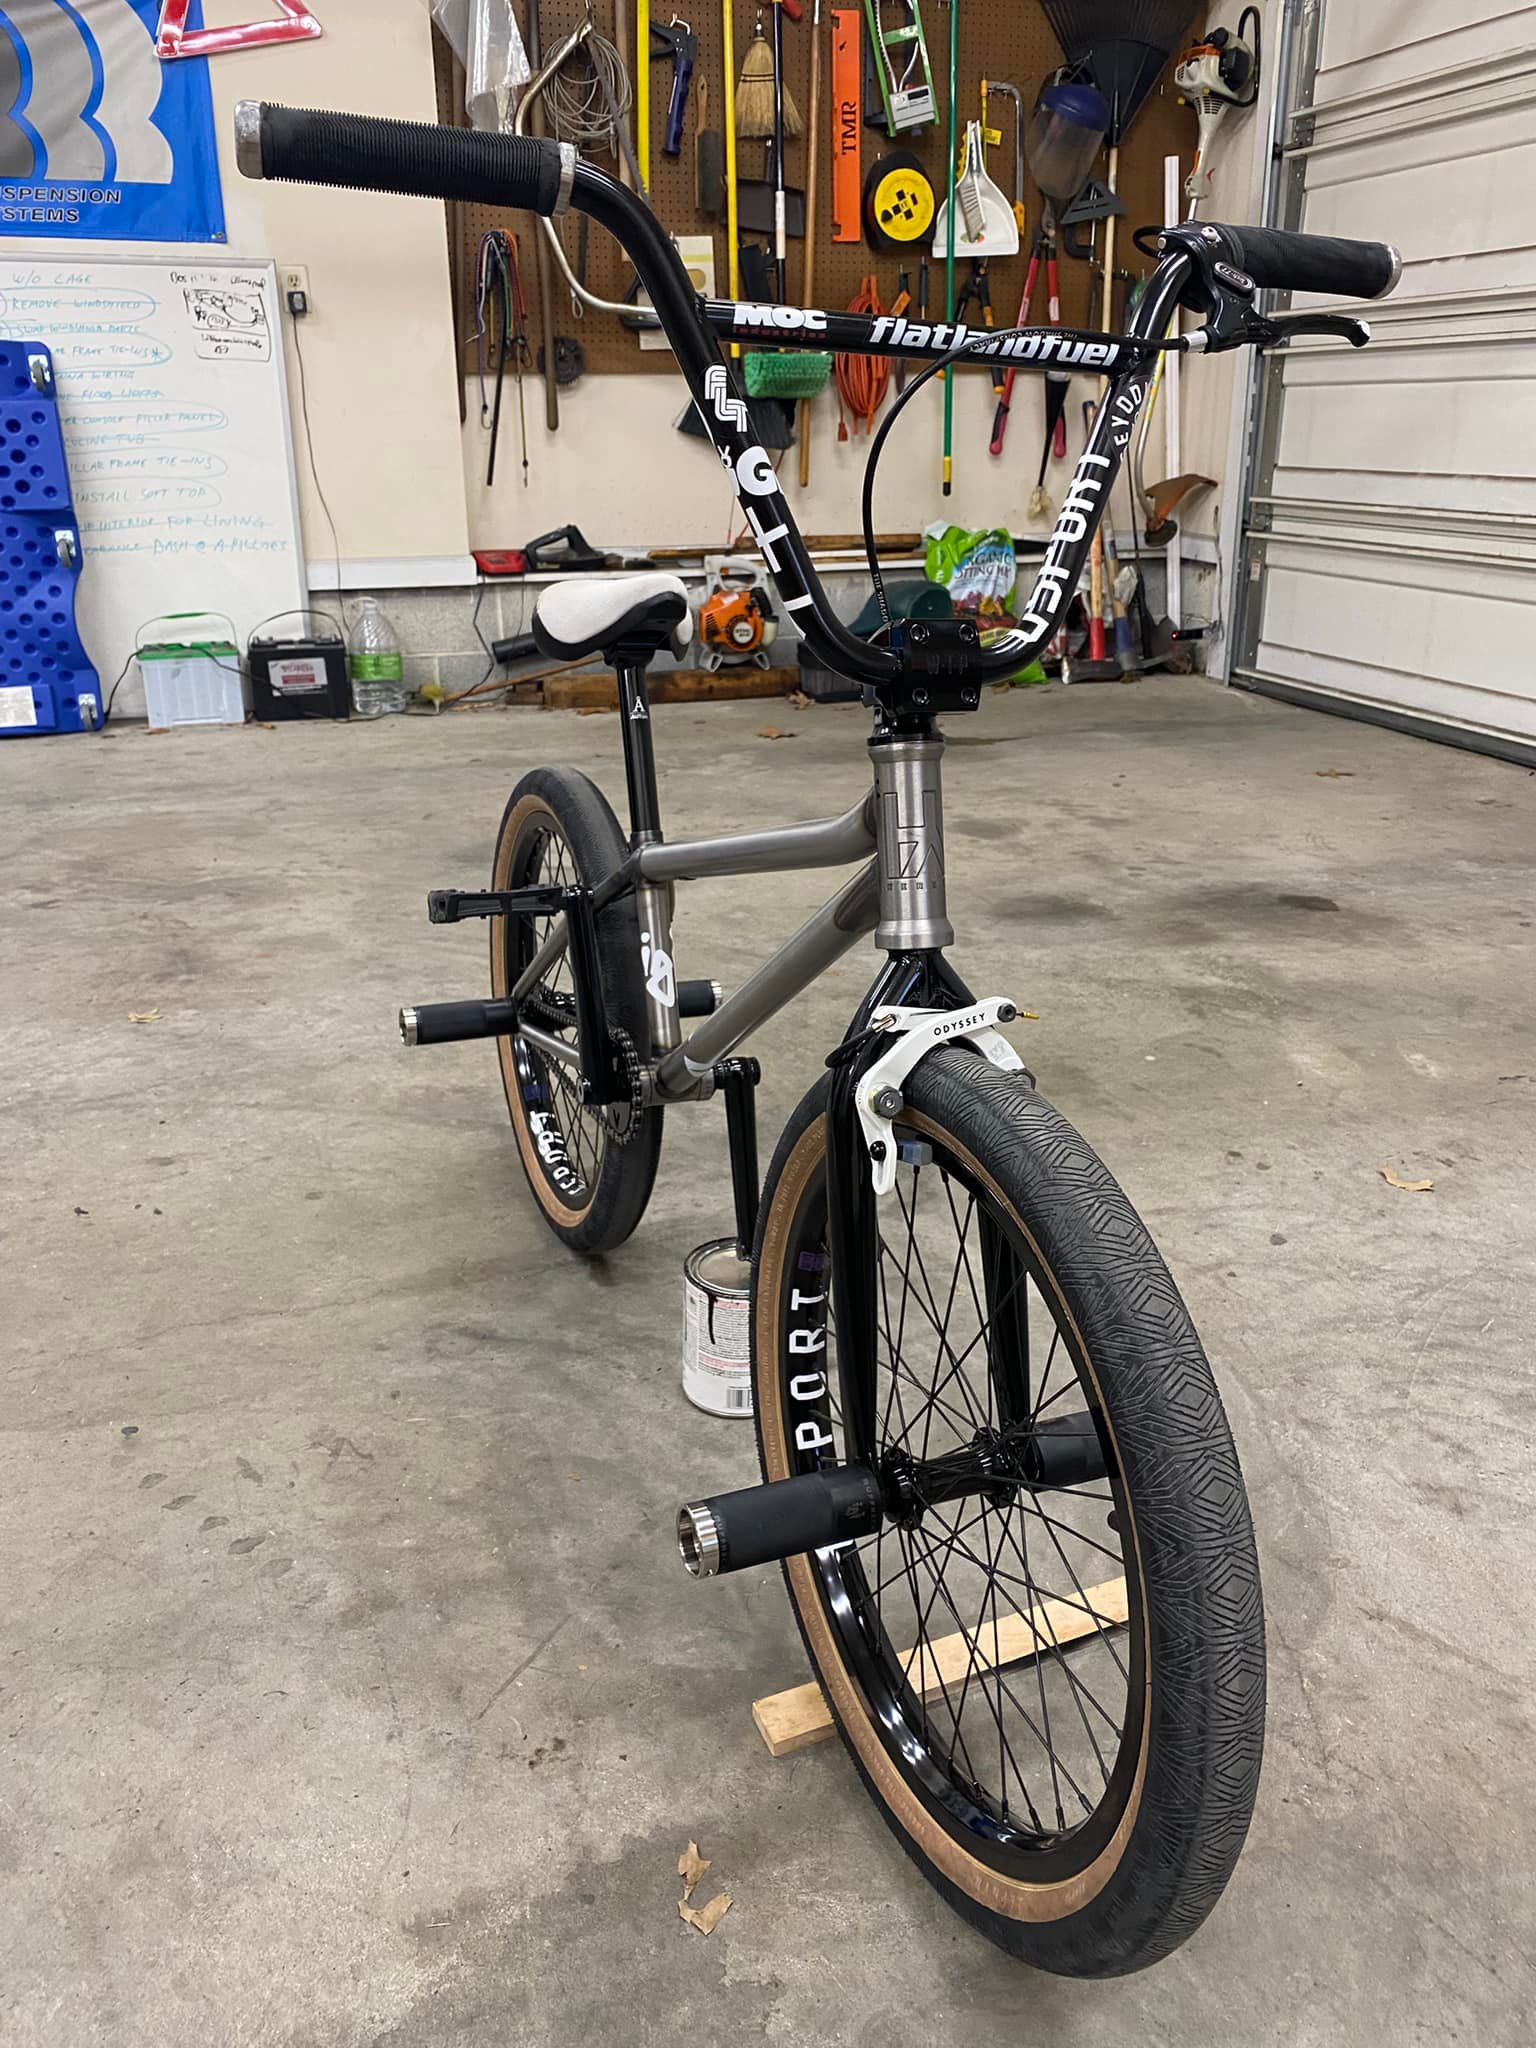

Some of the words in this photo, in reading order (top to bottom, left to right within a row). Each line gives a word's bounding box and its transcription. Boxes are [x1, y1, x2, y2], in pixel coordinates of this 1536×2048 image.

[840, 101, 857, 156] TMR
[0, 186, 121, 203] SPENSION
[0, 207, 79, 222] STEMS
[733, 304, 827, 330] MOC
[876, 592, 889, 623] SHADO
[933, 1012, 985, 1036] ODYSSEY
[788, 1288, 834, 1451] PORT
